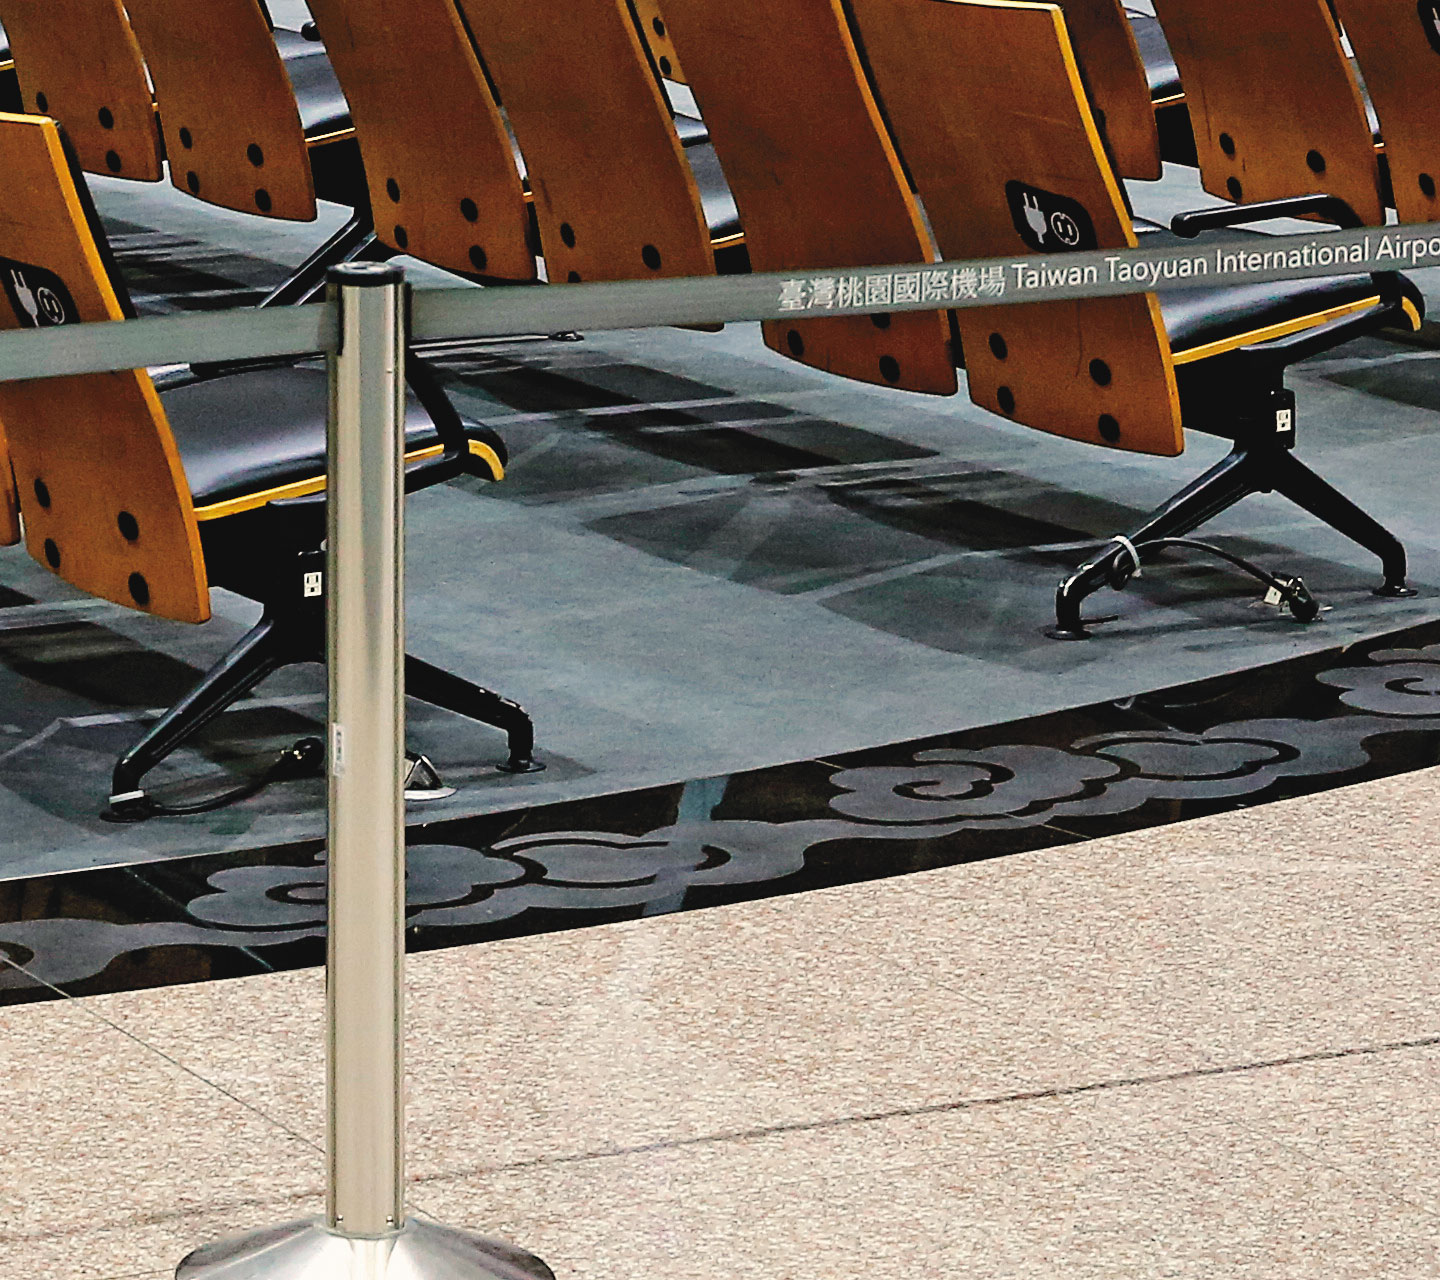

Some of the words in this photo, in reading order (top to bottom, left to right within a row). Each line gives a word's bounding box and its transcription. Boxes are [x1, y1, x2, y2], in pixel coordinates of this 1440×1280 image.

[778, 266, 1005, 311] 臺灣桃園國際機場
[1011, 263, 1097, 289] Taiwan
[1105, 256, 1208, 287] Taoyuan
[1216, 237, 1369, 274] International
